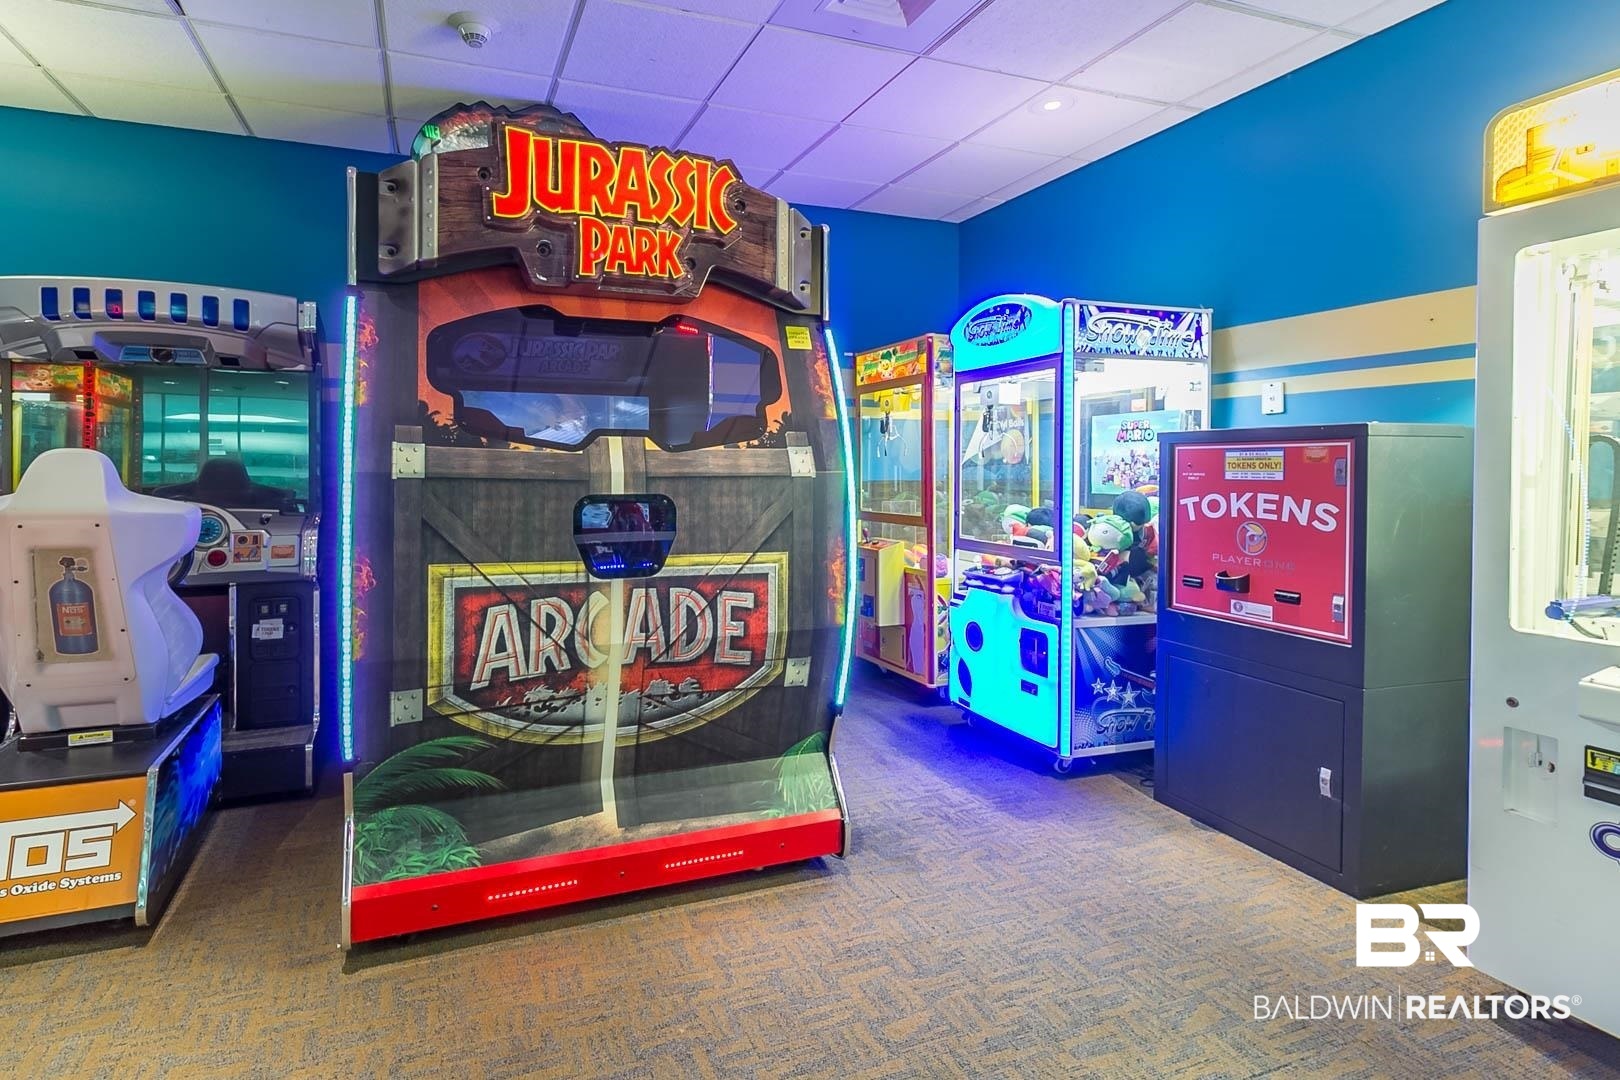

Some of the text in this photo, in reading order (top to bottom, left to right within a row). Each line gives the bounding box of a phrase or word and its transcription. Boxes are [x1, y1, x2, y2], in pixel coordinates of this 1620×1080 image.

[493, 125, 739, 235] JURASSIC
[578, 216, 685, 278] PARK
[1116, 429, 1155, 442] MARIO
[1121, 420, 1150, 430] SUPER
[1227, 461, 1282, 470] TOKENS ONLY!
[1180, 493, 1340, 532] TOKENS
[470, 587, 755, 691] ARCADE
[10, 881, 57, 897] Oxide
[58, 872, 122, 890] Systems
